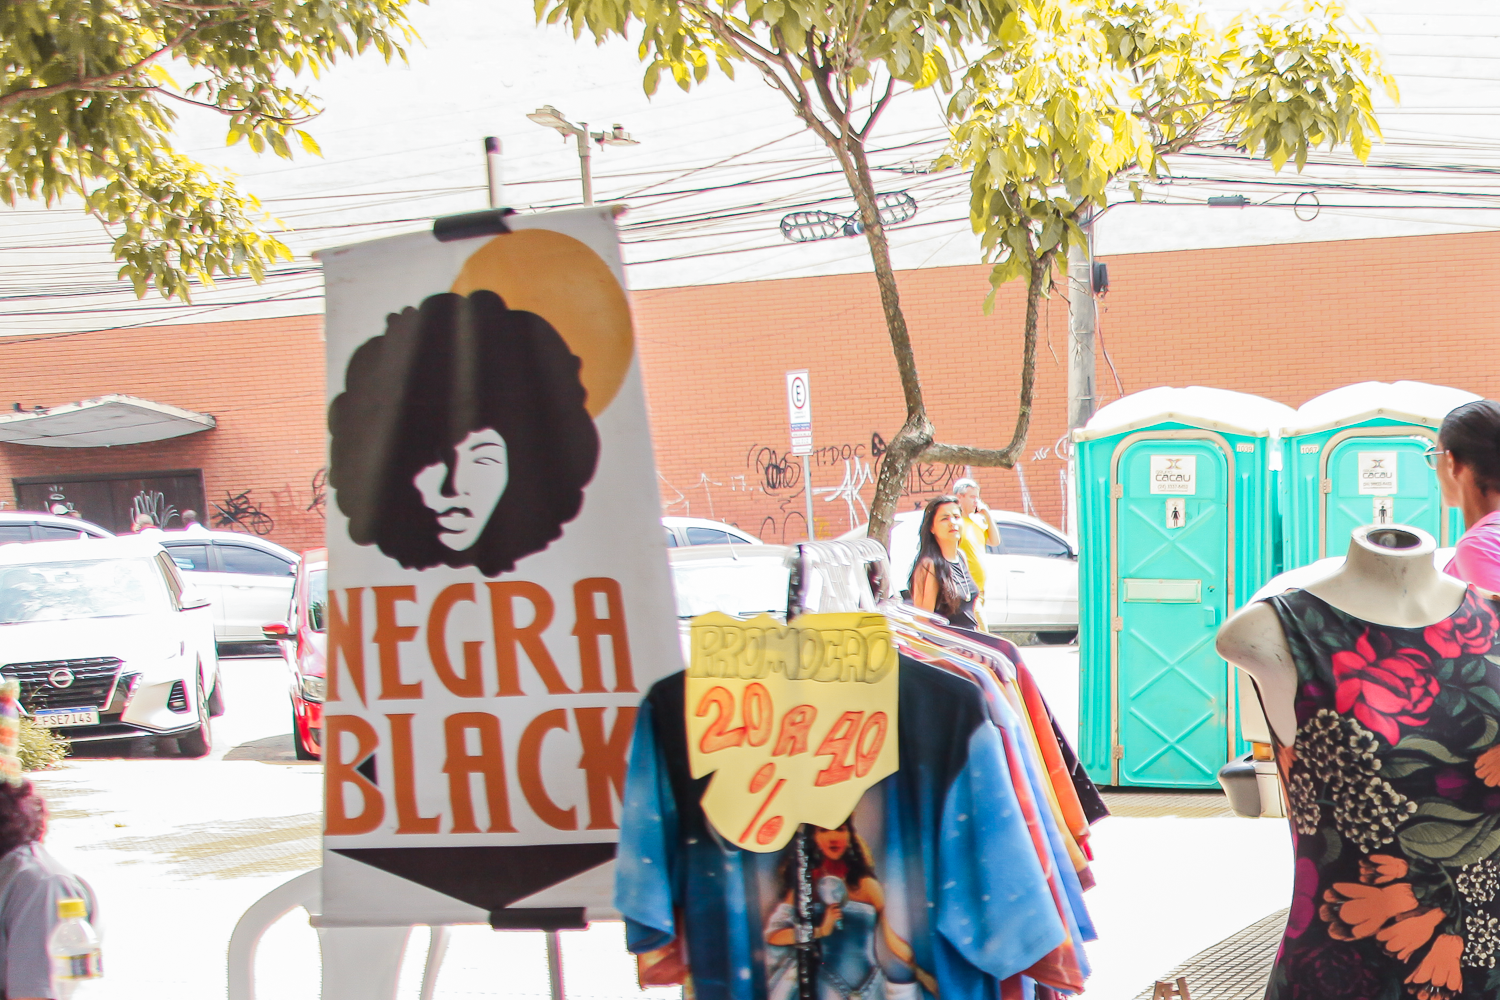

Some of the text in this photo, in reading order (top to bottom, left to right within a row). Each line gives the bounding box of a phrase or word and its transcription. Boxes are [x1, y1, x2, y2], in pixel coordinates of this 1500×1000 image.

[326, 577, 640, 710] NEGRA
[323, 706, 640, 836] BLACK
[695, 682, 774, 755] 20
[814, 711, 889, 787] 40
